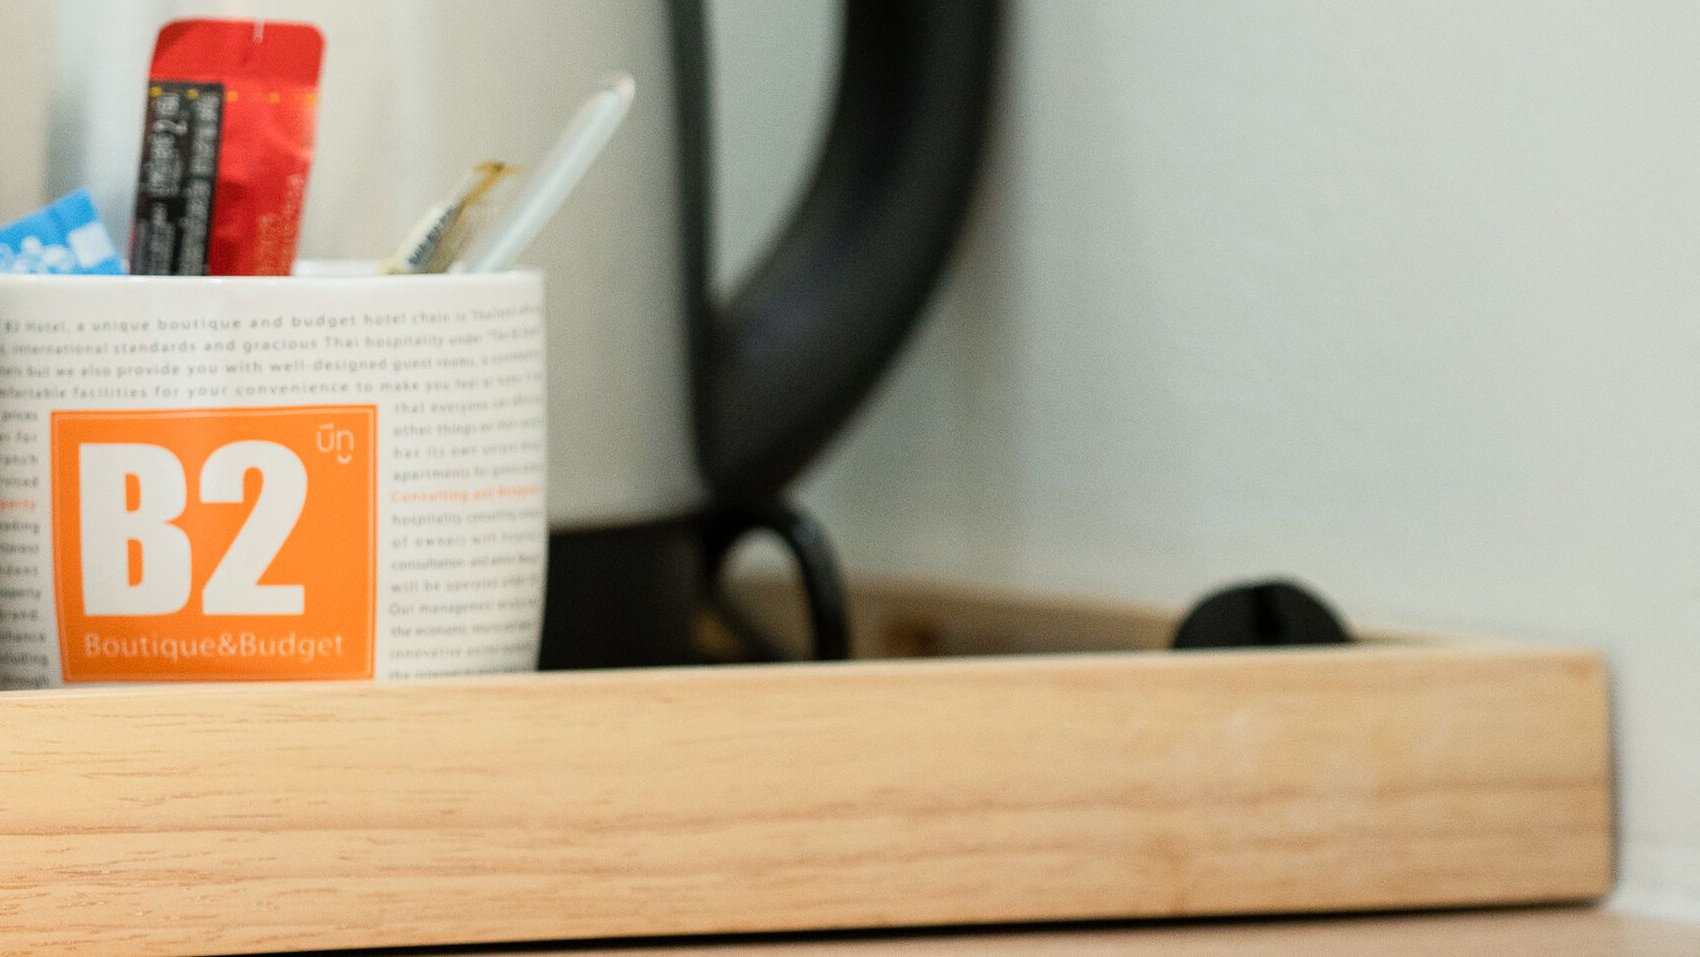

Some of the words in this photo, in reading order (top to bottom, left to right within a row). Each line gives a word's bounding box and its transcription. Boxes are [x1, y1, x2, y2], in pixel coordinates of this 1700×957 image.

[156, 317, 242, 332] boutique
[249, 315, 284, 330] and
[290, 314, 356, 330] budget
[363, 312, 407, 326] hotel
[113, 340, 198, 355] standards
[203, 339, 237, 353] and
[243, 340, 318, 355] gracious
[324, 336, 360, 350] Thai
[116, 363, 181, 379] provide
[187, 365, 219, 378] you
[224, 360, 262, 374] with
[154, 385, 180, 398] for
[187, 386, 228, 400] your
[235, 384, 349, 397] convenience
[356, 380, 373, 393] to
[79, 438, 309, 617] B2
[83, 630, 344, 665] Boutique&Budget
